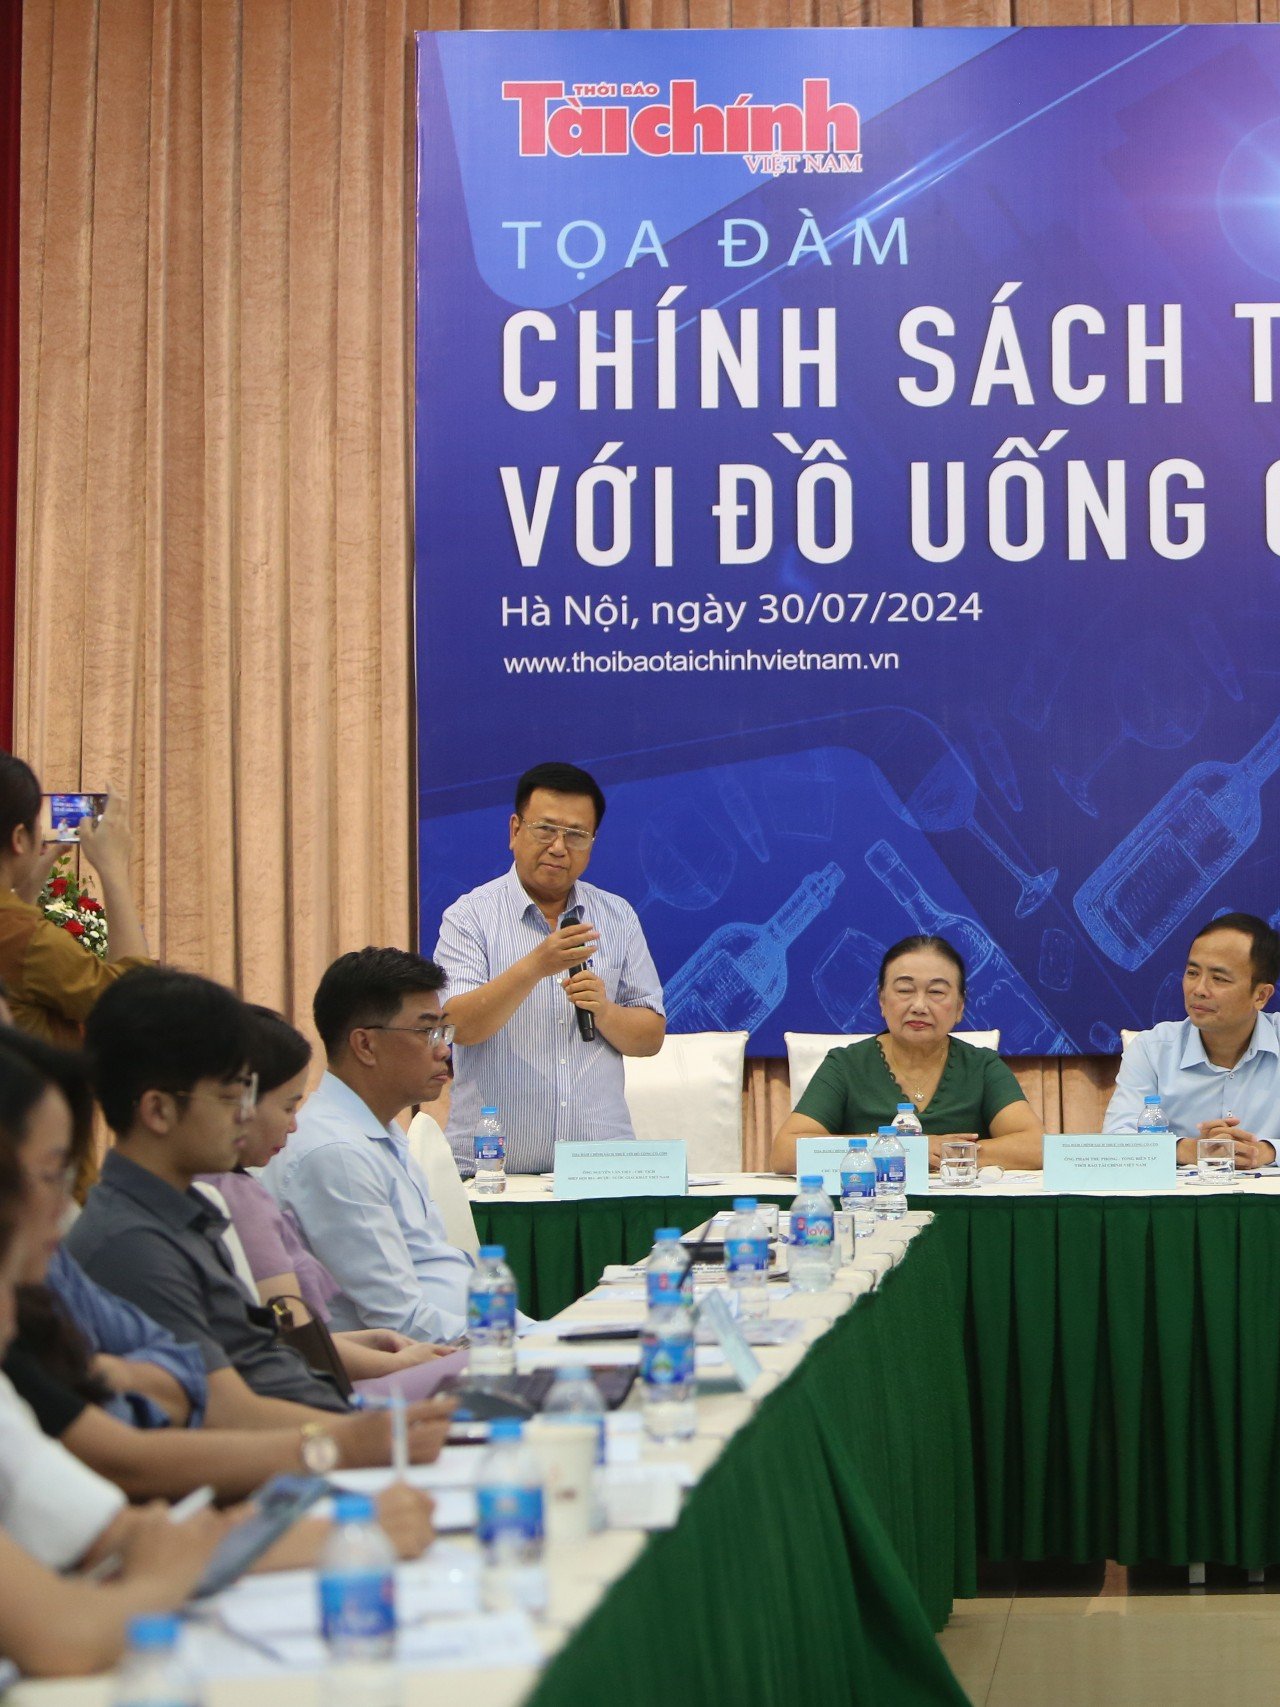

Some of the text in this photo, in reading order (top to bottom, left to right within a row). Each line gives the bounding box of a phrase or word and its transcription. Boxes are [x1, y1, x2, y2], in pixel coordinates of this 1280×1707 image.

[570, 82, 660, 98] THỜI BÁO
[743, 152, 864, 177] VIỆT NAM
[502, 208, 910, 281] TỌA ĐÀM
[503, 285, 837, 412] CHÍNH
[898, 281, 1182, 407] SÁCH
[500, 441, 673, 567] VỚI
[712, 432, 853, 565] ĐỒ
[911, 429, 1205, 563] UỐNG
[501, 591, 984, 633] Hà Nội, ngày 30/07/2024
[503, 648, 900, 673] www.thoibaotaichinhvietnam.vn
